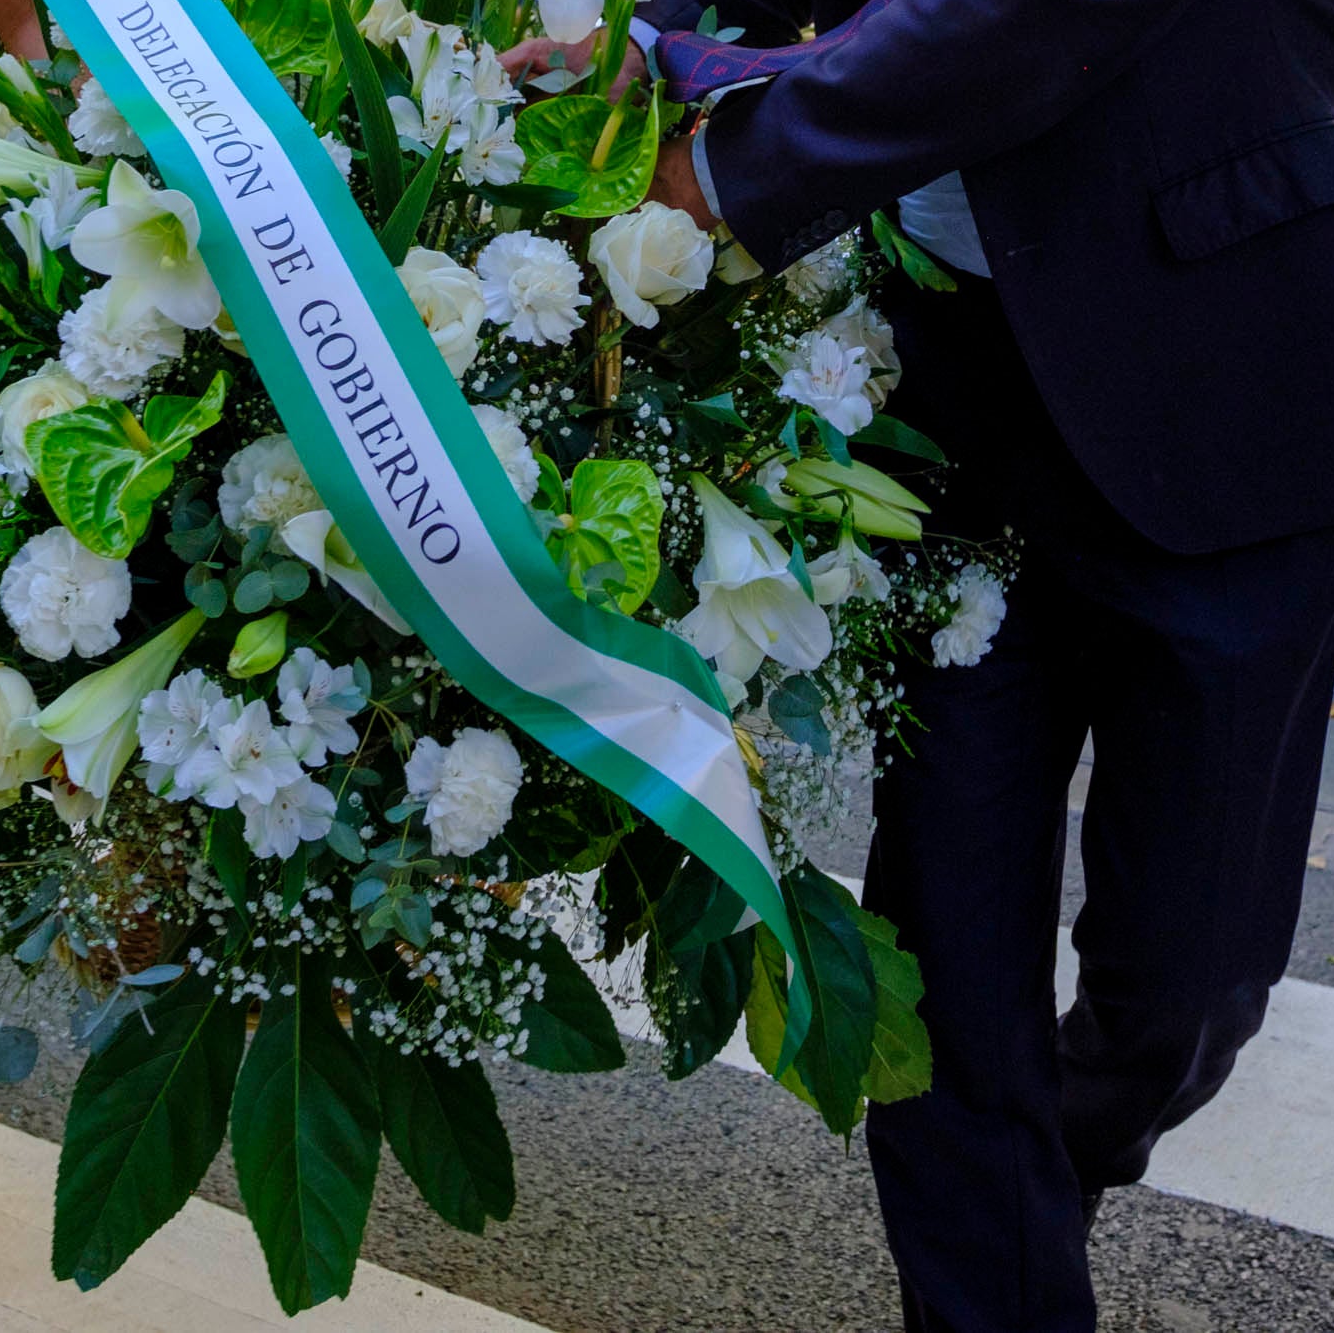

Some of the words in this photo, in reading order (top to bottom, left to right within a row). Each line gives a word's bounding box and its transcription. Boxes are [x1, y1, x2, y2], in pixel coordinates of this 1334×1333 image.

[117, 1, 275, 199] DELEGACIÓN
[251, 214, 314, 285] DE
[299, 299, 460, 564] GOBIERNO
